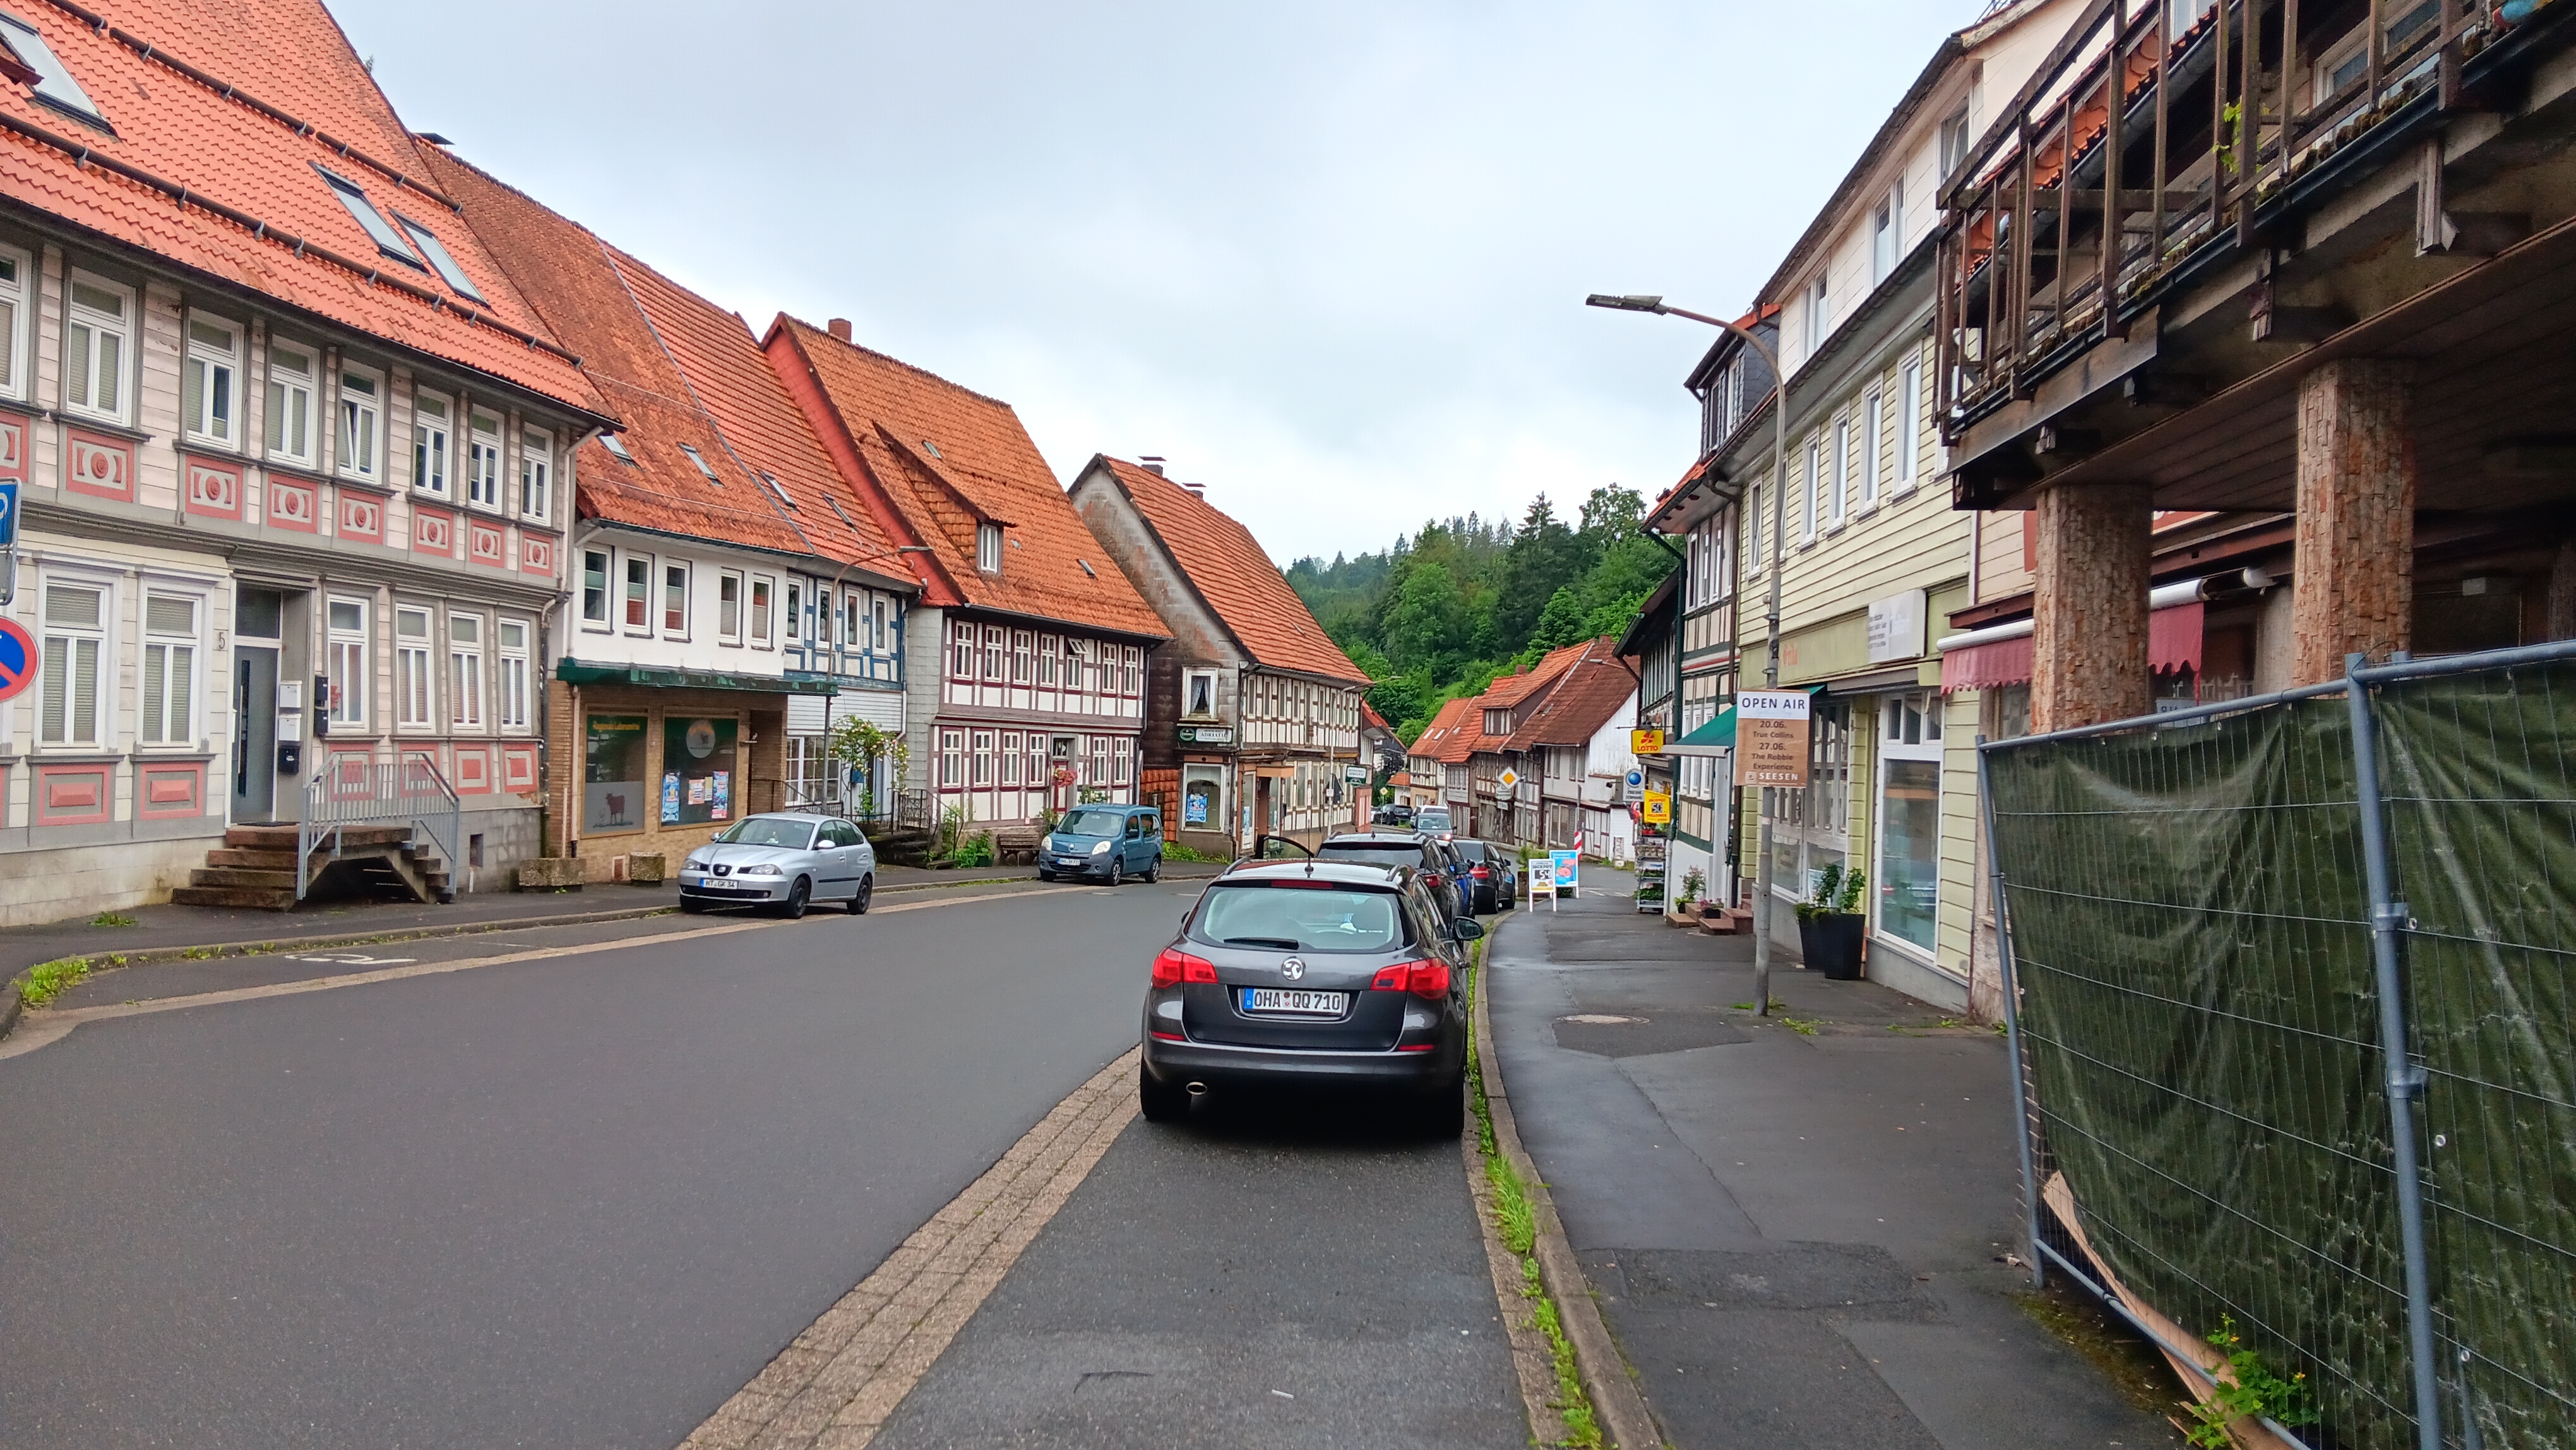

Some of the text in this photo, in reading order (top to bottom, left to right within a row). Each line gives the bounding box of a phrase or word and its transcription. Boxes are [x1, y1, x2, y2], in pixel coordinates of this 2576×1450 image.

[218, 632, 225, 649] 5
[1741, 697, 1805, 710] OPEN AIR
[1759, 720, 1787, 729] 20.06.
[1753, 731, 1768, 739] True
[1758, 742, 1787, 751] 27.06.
[1767, 753, 1794, 761] Robbie
[1753, 763, 1794, 771] Experience
[1758, 772, 1798, 781] SEESEN
[1254, 992, 1281, 1008] OHA
[1292, 992, 1311, 1009] QQ
[1313, 993, 1340, 1010] 710
